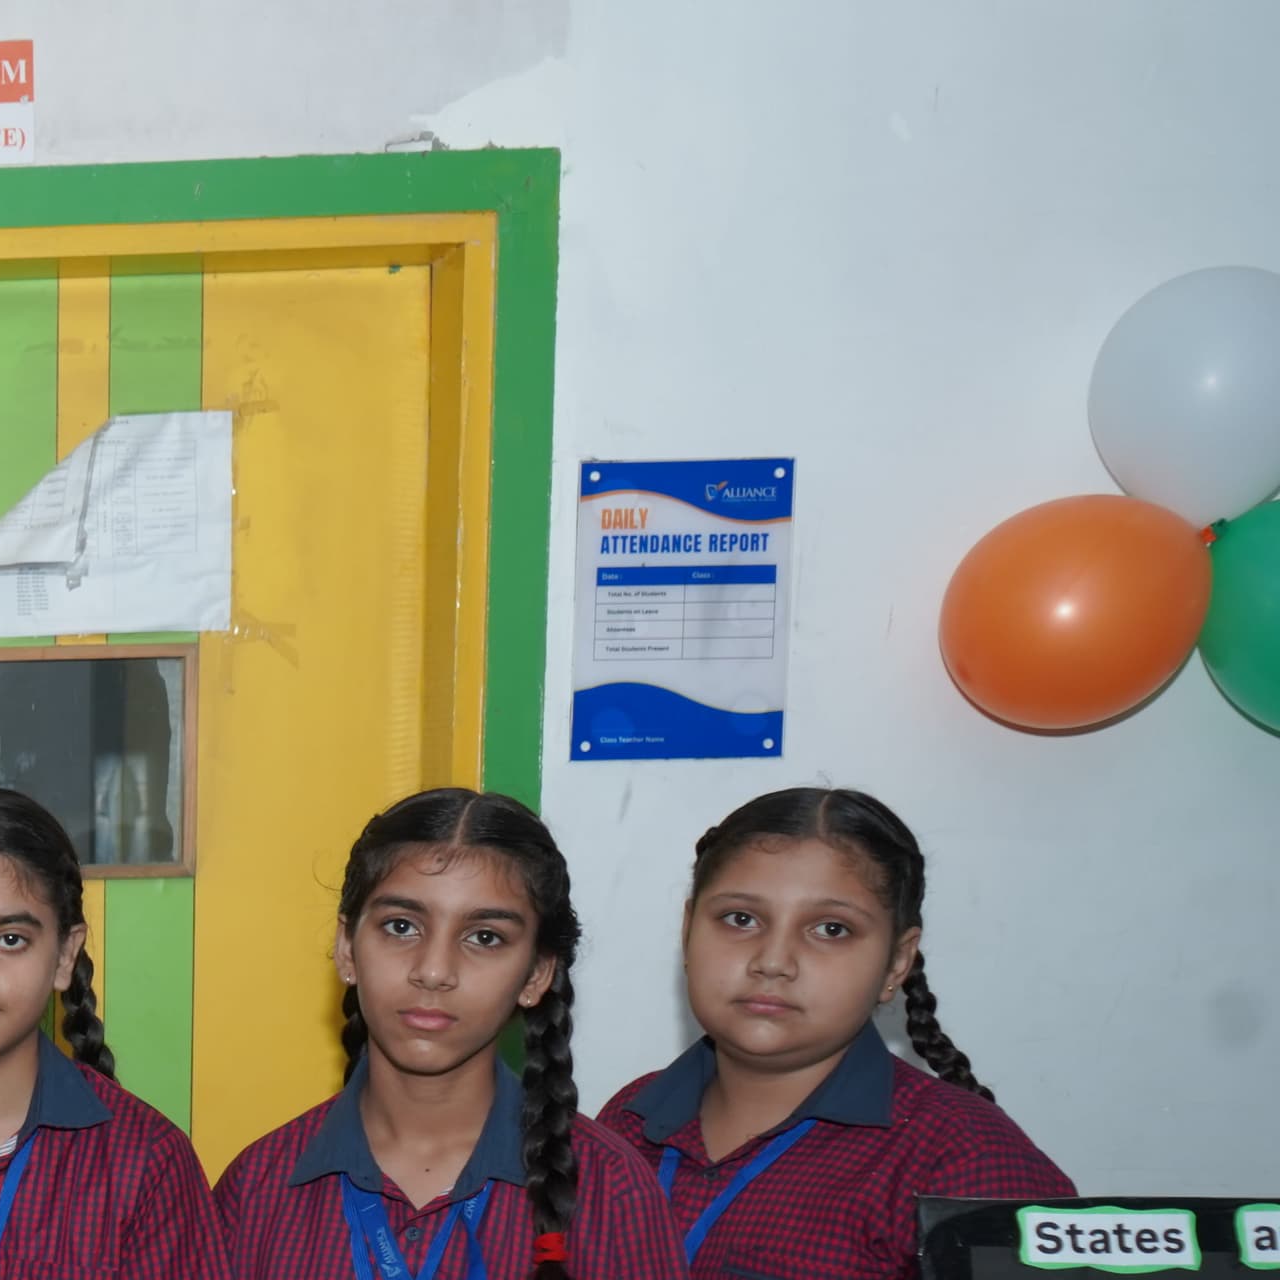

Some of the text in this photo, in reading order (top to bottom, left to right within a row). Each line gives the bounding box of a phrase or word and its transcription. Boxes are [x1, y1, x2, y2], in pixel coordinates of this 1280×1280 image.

[722, 486, 777, 499] ALLIANCE
[601, 507, 648, 530] DAILY
[600, 533, 770, 555] ATTENDANCE REPORT
[1035, 1221, 1186, 1255] States
